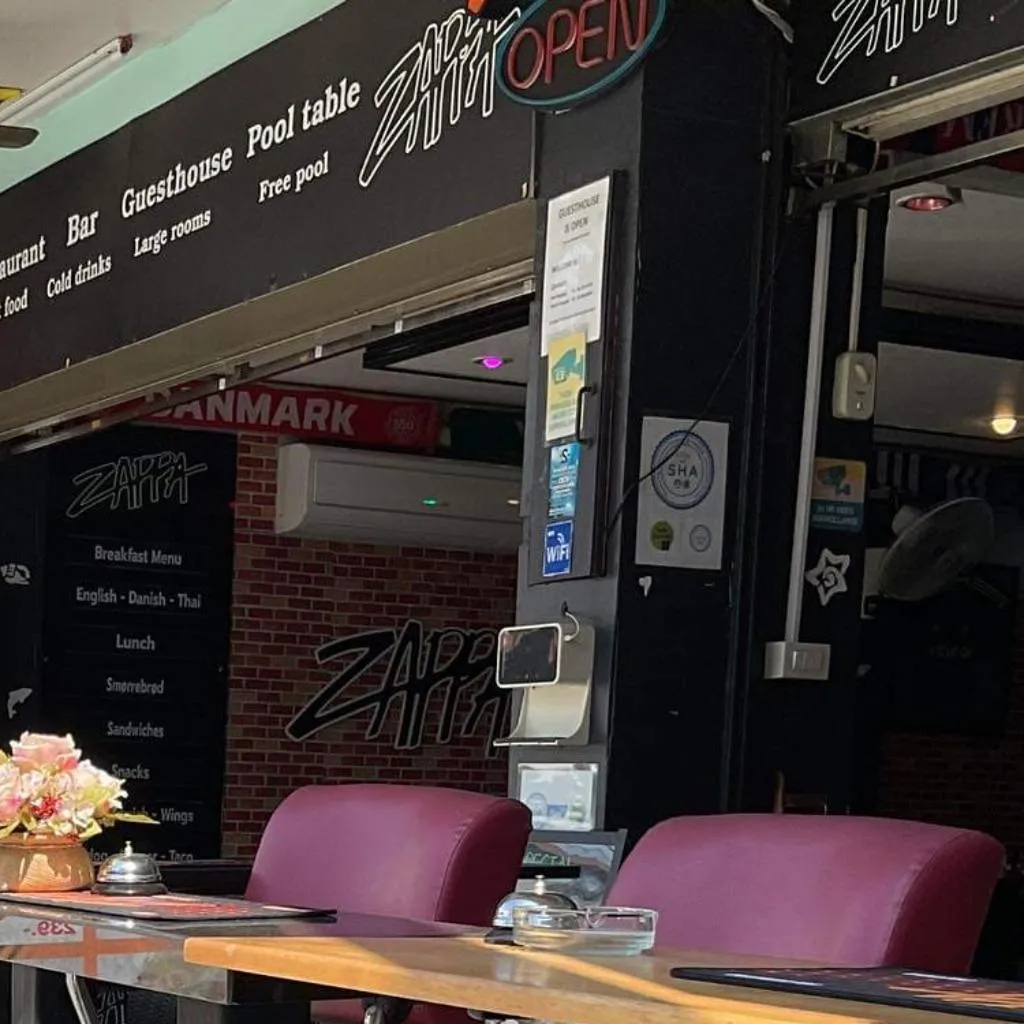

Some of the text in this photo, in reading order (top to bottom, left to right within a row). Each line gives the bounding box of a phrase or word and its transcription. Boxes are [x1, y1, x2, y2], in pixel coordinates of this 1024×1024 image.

[507, 0, 647, 90] OPEN
[66, 209, 99, 248] Bar
[121, 145, 233, 220] Guesthouse
[246, 117, 295, 159] Pool
[302, 78, 361, 131] table
[258, 153, 329, 203] Free pool
[134, 208, 211, 258] Large rooms
[47, 254, 112, 298] Cold drinks
[4, 287, 28, 318] food
[667, 463, 698, 478] SHA
[66, 451, 209, 518] ZAPPA
[94, 545, 183, 566] Breakfast Menu
[76, 586, 118, 605] English
[128, 590, 166, 607] Danish
[178, 593, 202, 609] Thai
[115, 633, 156, 652] Lunch
[107, 722, 164, 739] Sandwiches
[111, 763, 151, 780] Snacks
[161, 807, 195, 825] Wings
